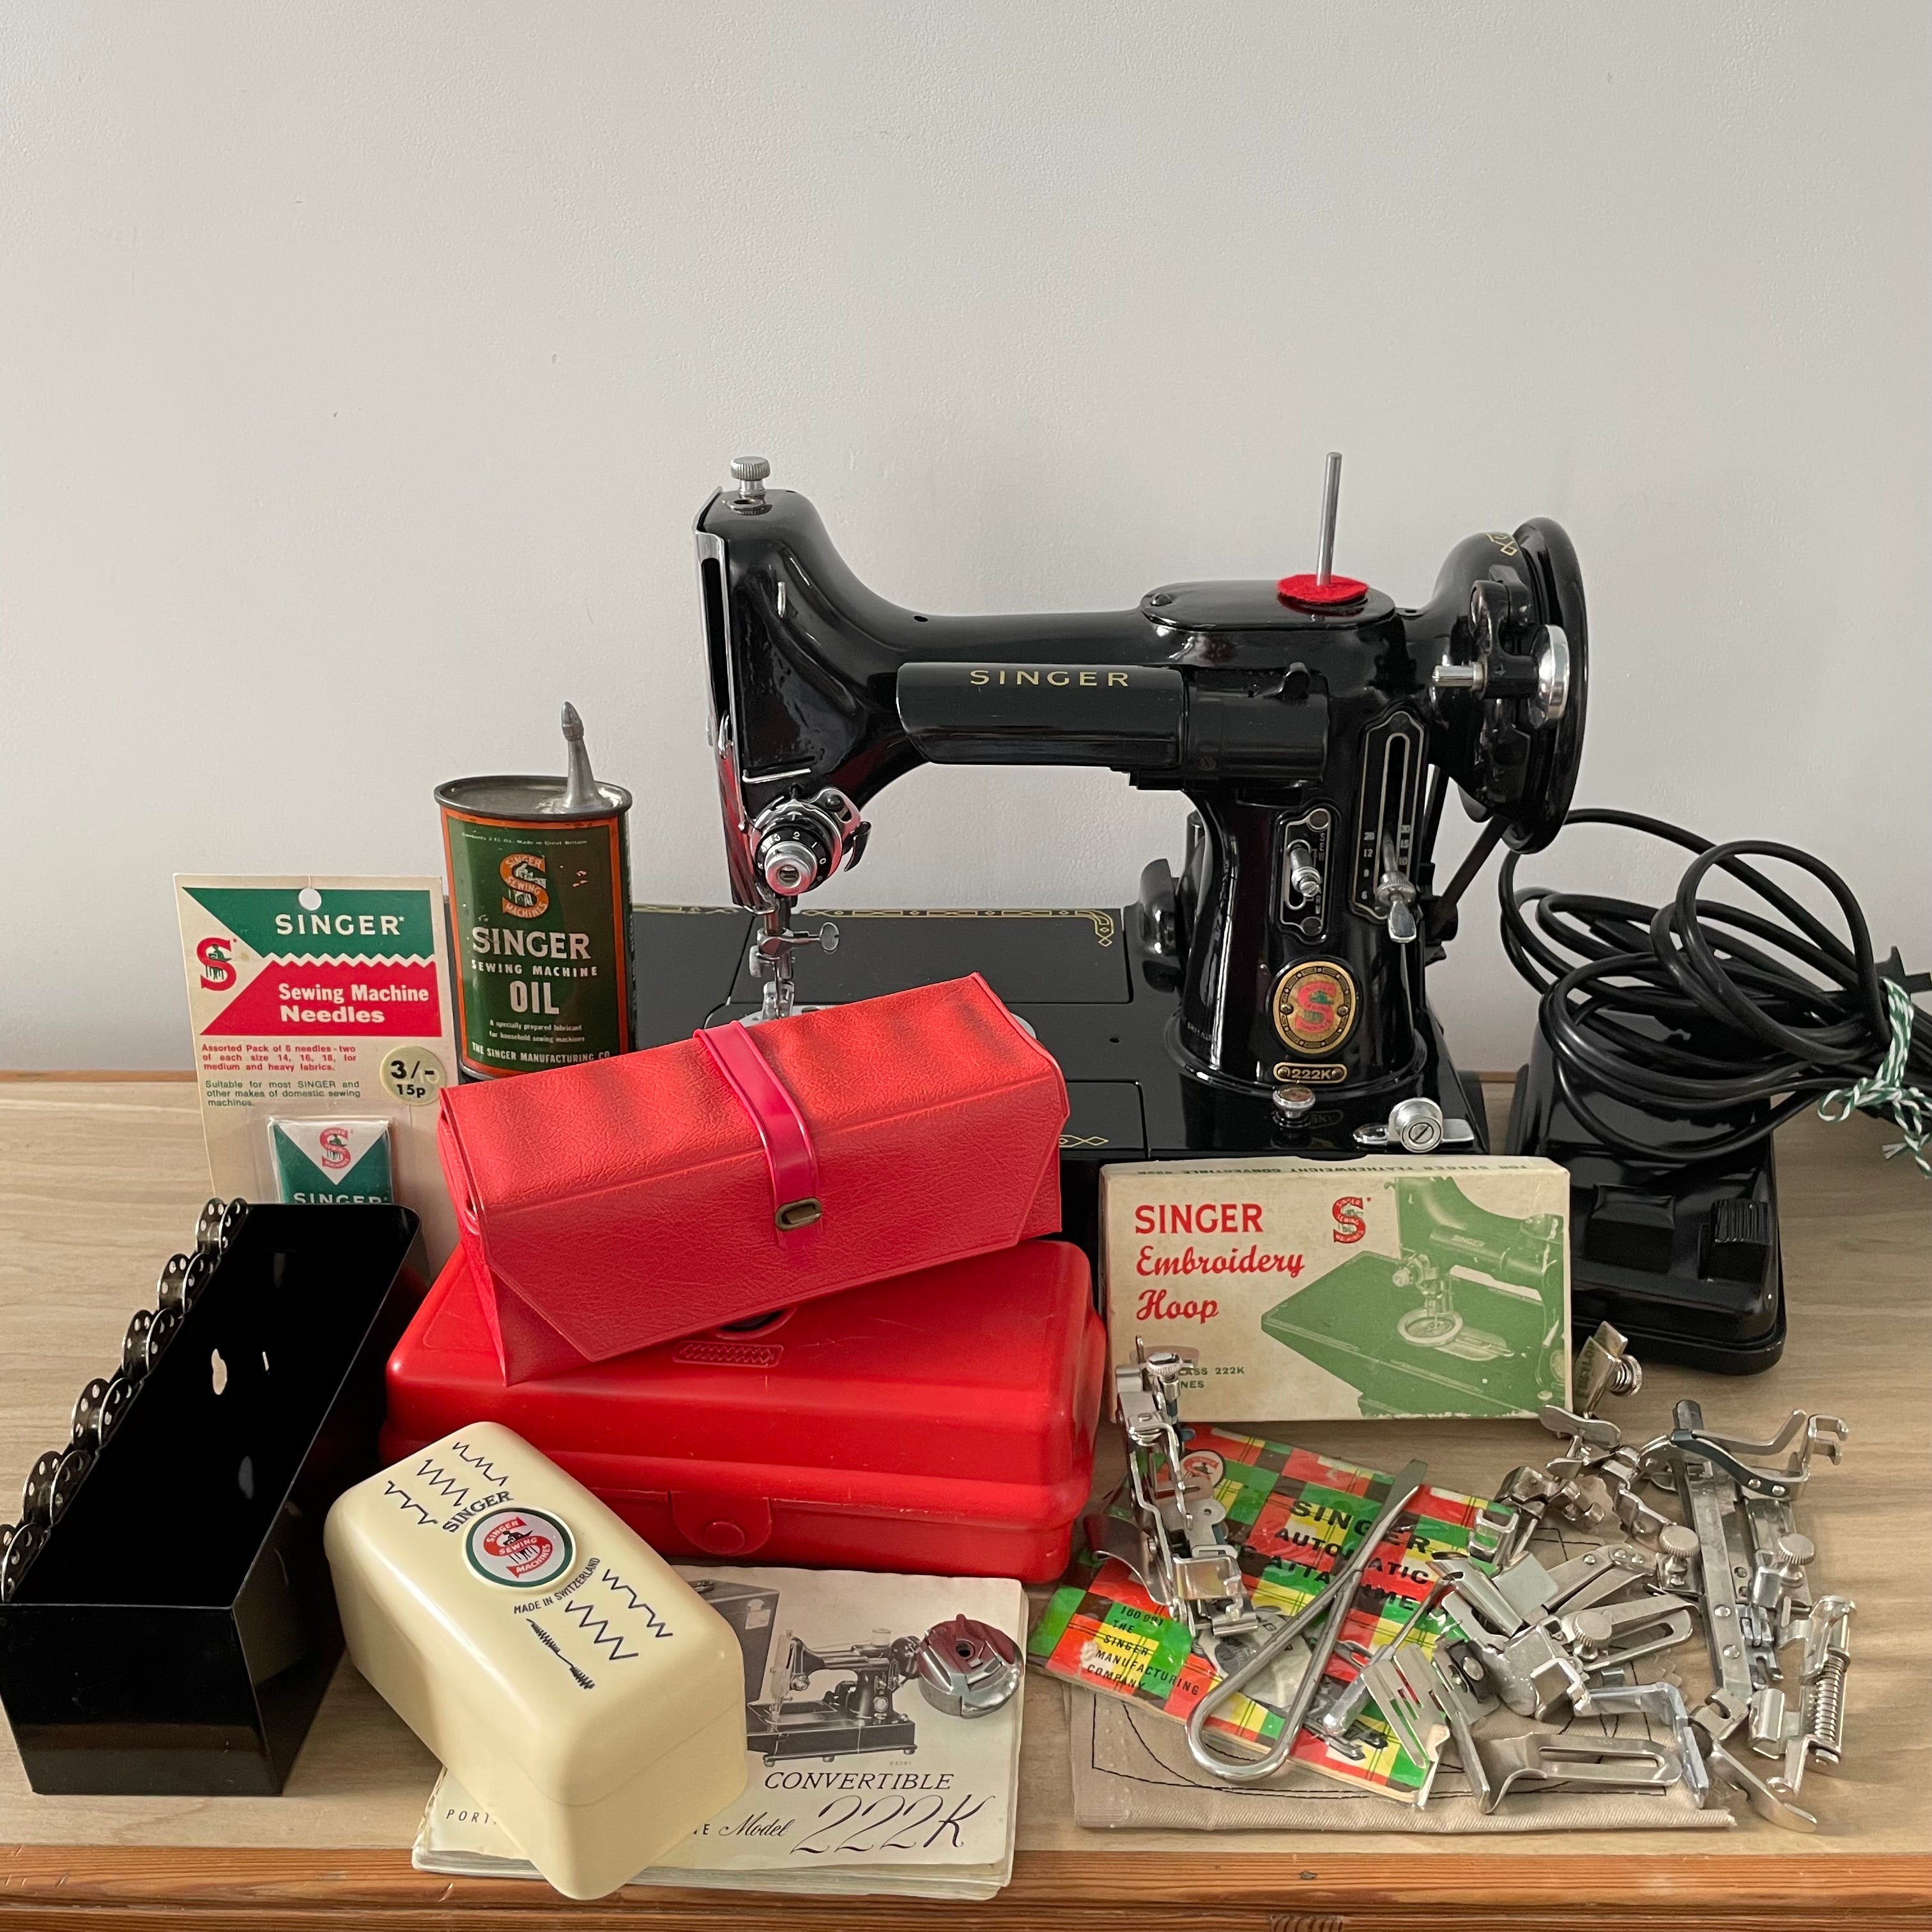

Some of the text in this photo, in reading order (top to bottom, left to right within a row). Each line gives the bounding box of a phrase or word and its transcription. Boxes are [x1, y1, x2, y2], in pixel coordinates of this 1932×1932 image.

[970, 670, 1129, 687] SINGER
[792, 831, 800, 840] 2
[505, 856, 542, 869] SINGER
[1363, 849, 1373, 857] 12
[505, 876, 540, 895] SEWING
[505, 902, 548, 918] MACHINES
[275, 914, 401, 936] SINGER
[471, 926, 591, 960] SINGER
[471, 959, 598, 977] SEWING MACHINE
[279, 984, 429, 1004] Sewing Machine
[509, 980, 560, 1015] OIL
[280, 1005, 385, 1023] Needles
[496, 1022, 521, 1030] specially
[524, 1023, 551, 1031] prepared
[202, 1044, 241, 1052] Assorted
[471, 1041, 484, 1054] THE
[487, 1047, 516, 1061] SINGER
[520, 1052, 594, 1063] MANUFACTURING
[269, 1063, 295, 1071] heavy
[1291, 1068, 1331, 1080] 222K
[397, 1084, 425, 1098] 15p
[1135, 1203, 1263, 1234] SINGER
[1136, 1245, 1305, 1278] Embroidery
[1136, 1289, 1219, 1324] Hoop
[1215, 1367, 1245, 1375] 222K
[443, 1491, 514, 1532] SINGER
[487, 1520, 519, 1543] SINGER
[499, 1537, 537, 1555] SEWING
[516, 1544, 551, 1573] MACHINES
[1275, 1528, 1429, 1584] AUTOATIC
[514, 1556, 601, 1614] MADE IN SWITZERLAND
[1112, 1620, 1135, 1634] THE
[1103, 1635, 1149, 1656] SINGER
[1087, 1664, 1145, 1691] COMPANY
[1095, 1650, 1199, 1696] MANUFACTURING
[765, 1772, 954, 1790] CONVERTIBLE
[719, 1811, 795, 1837] Model
[790, 1794, 995, 1854] 222K
